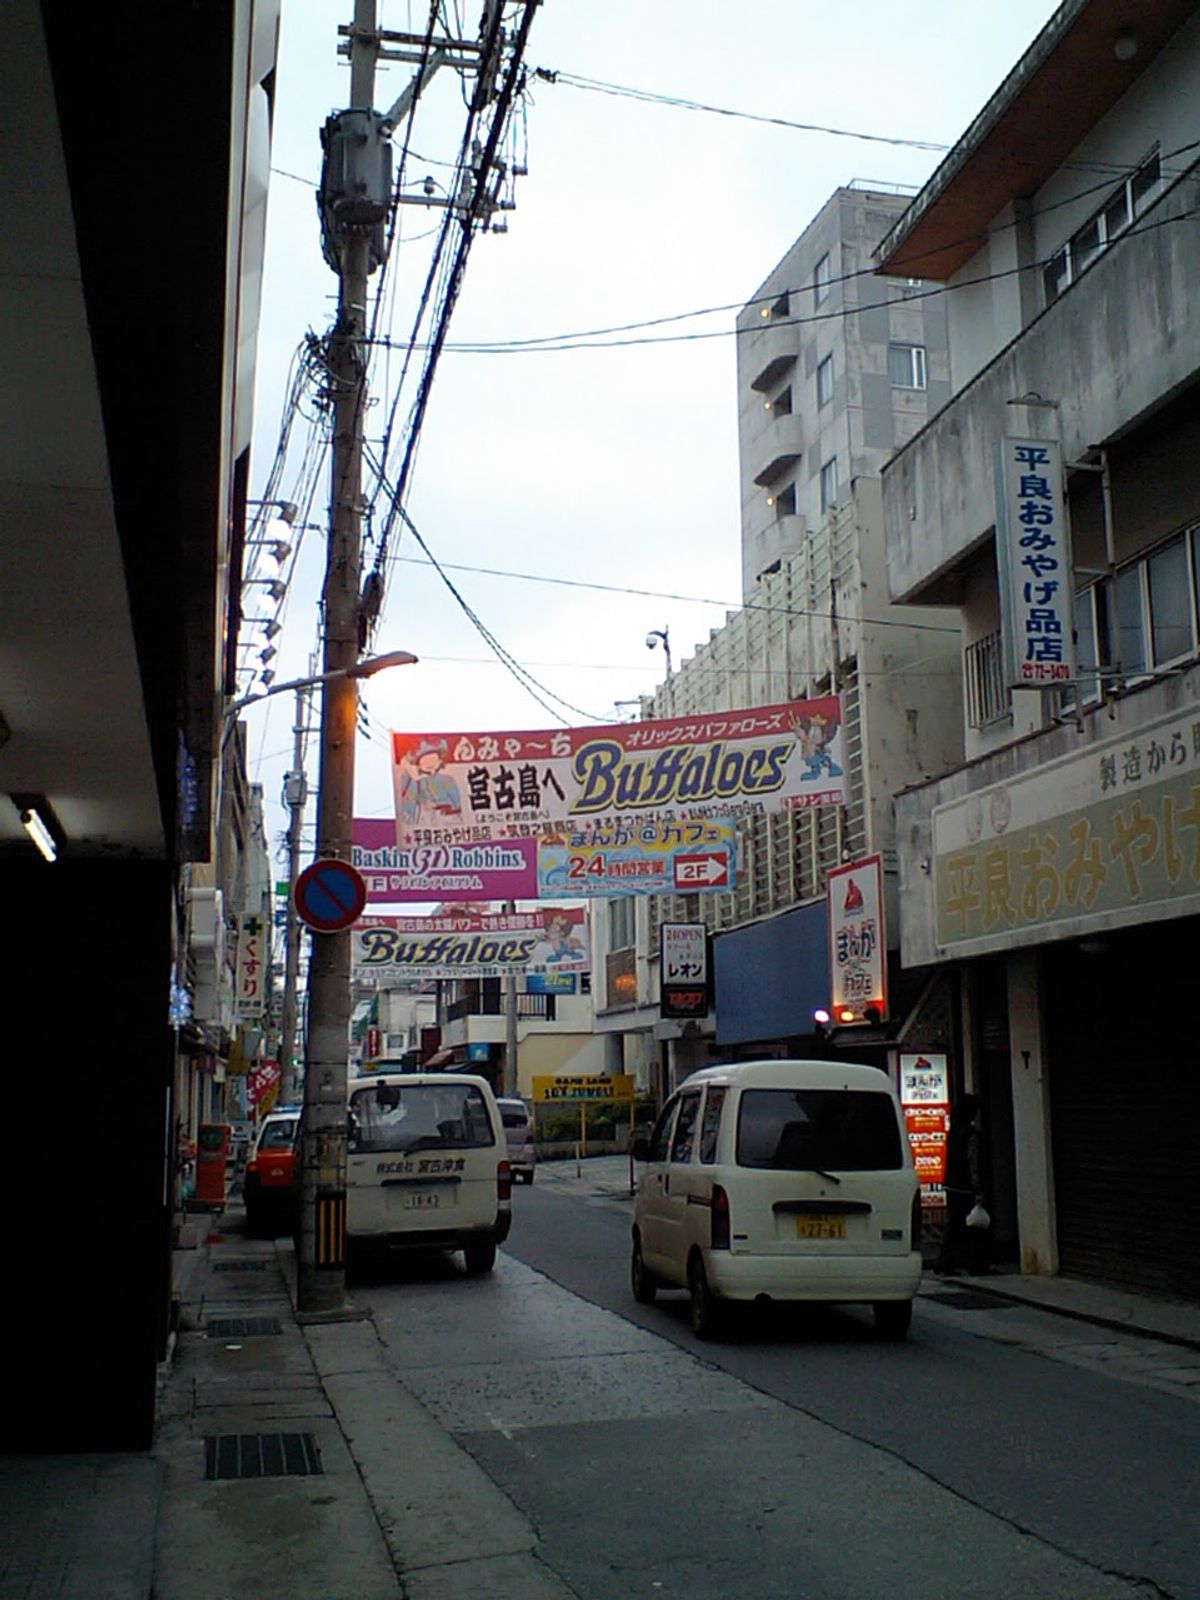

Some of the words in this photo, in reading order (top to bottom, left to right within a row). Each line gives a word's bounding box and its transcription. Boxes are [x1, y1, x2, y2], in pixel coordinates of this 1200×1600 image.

[1014, 445, 1063, 663] 平良おみやげ品店
[466, 761, 567, 811] 宮古島へ
[569, 740, 794, 814] Buffaloes
[351, 847, 410, 868] Baskin
[452, 848, 521, 869] Robbins
[683, 863, 707, 879] 2F
[242, 938, 261, 997] くすり
[356, 929, 537, 967] Buffaloes
[668, 963, 702, 979] レオン
